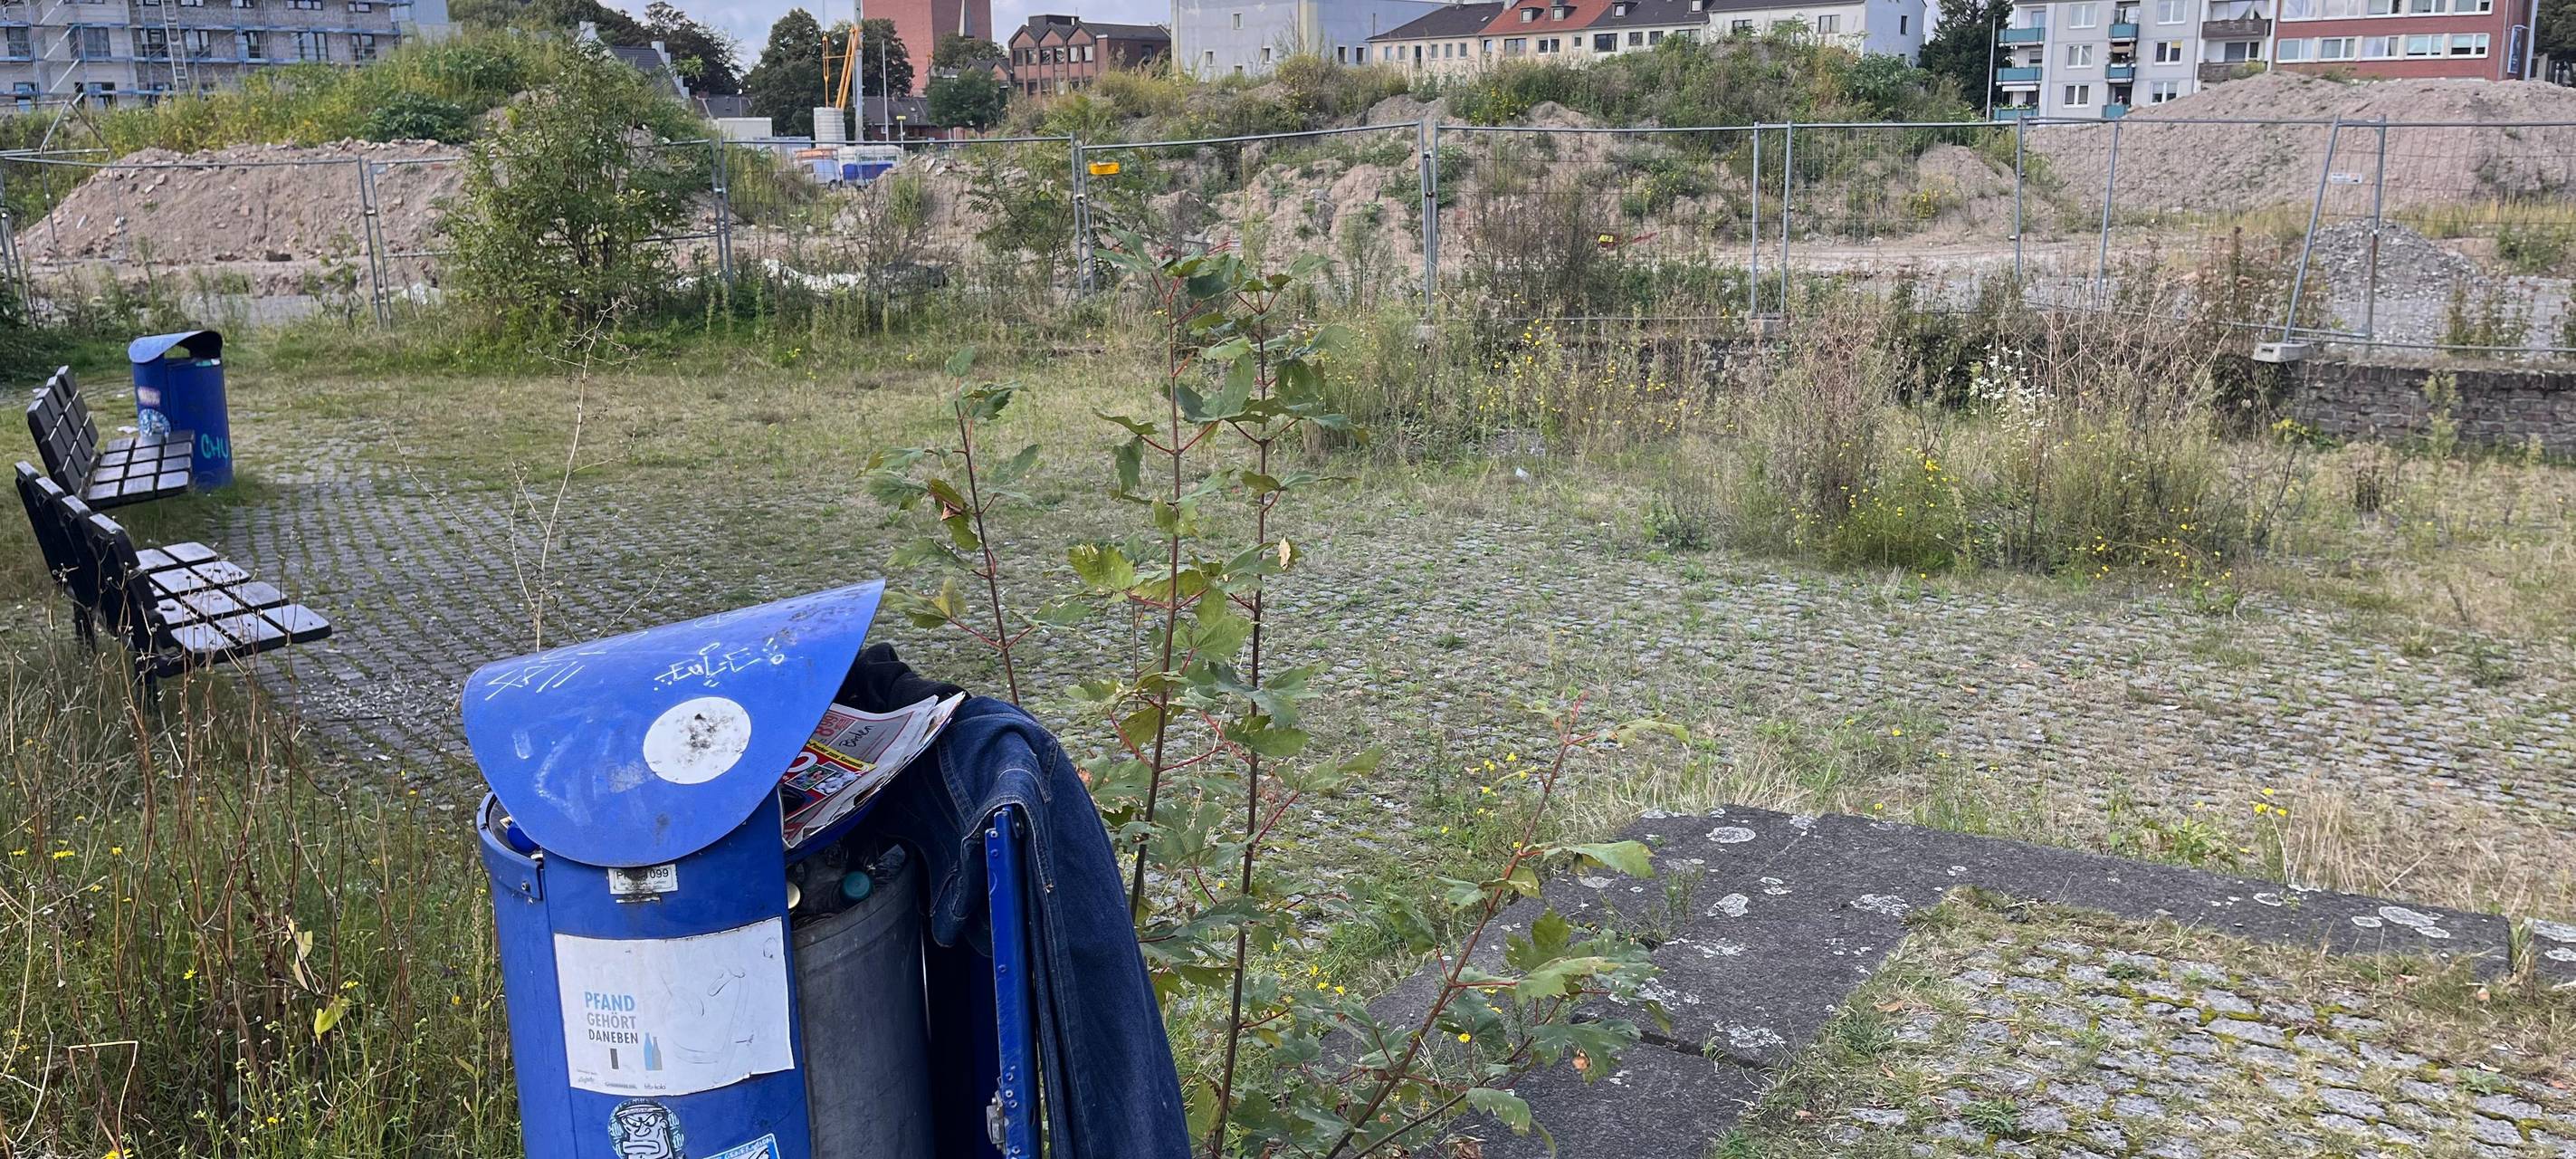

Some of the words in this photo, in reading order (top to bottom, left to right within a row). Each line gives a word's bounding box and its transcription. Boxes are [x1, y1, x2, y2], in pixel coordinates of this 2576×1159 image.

[584, 991, 635, 1011] PFAND
[587, 1011, 636, 1030] GEHÖRT
[588, 1029, 639, 1044] DANEBEN
